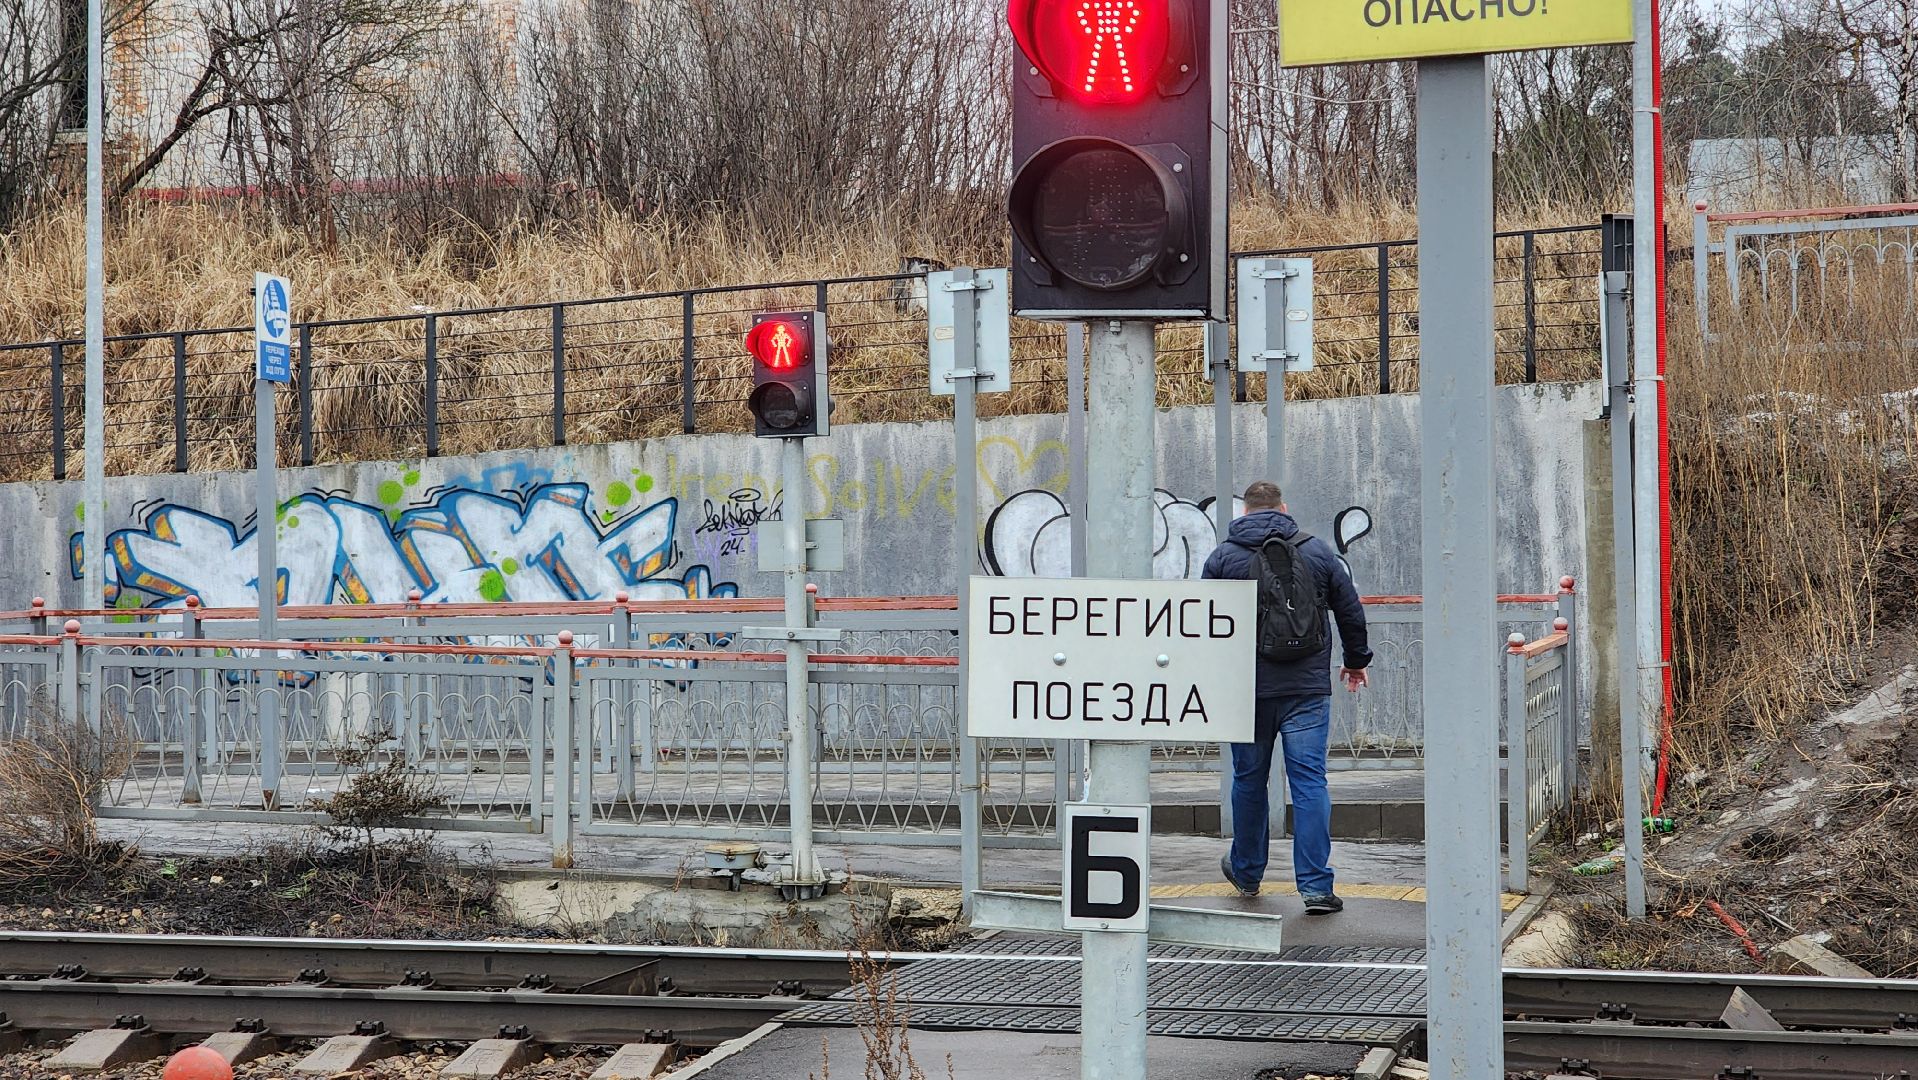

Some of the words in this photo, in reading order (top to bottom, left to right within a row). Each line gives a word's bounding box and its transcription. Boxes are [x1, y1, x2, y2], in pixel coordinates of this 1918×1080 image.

[667, 453, 784, 504] Iren
[989, 596, 1235, 639] БЕРЕГИСЬ
[1013, 680, 1209, 727] ПОЕЗДА
[1070, 816, 1140, 919] Б
